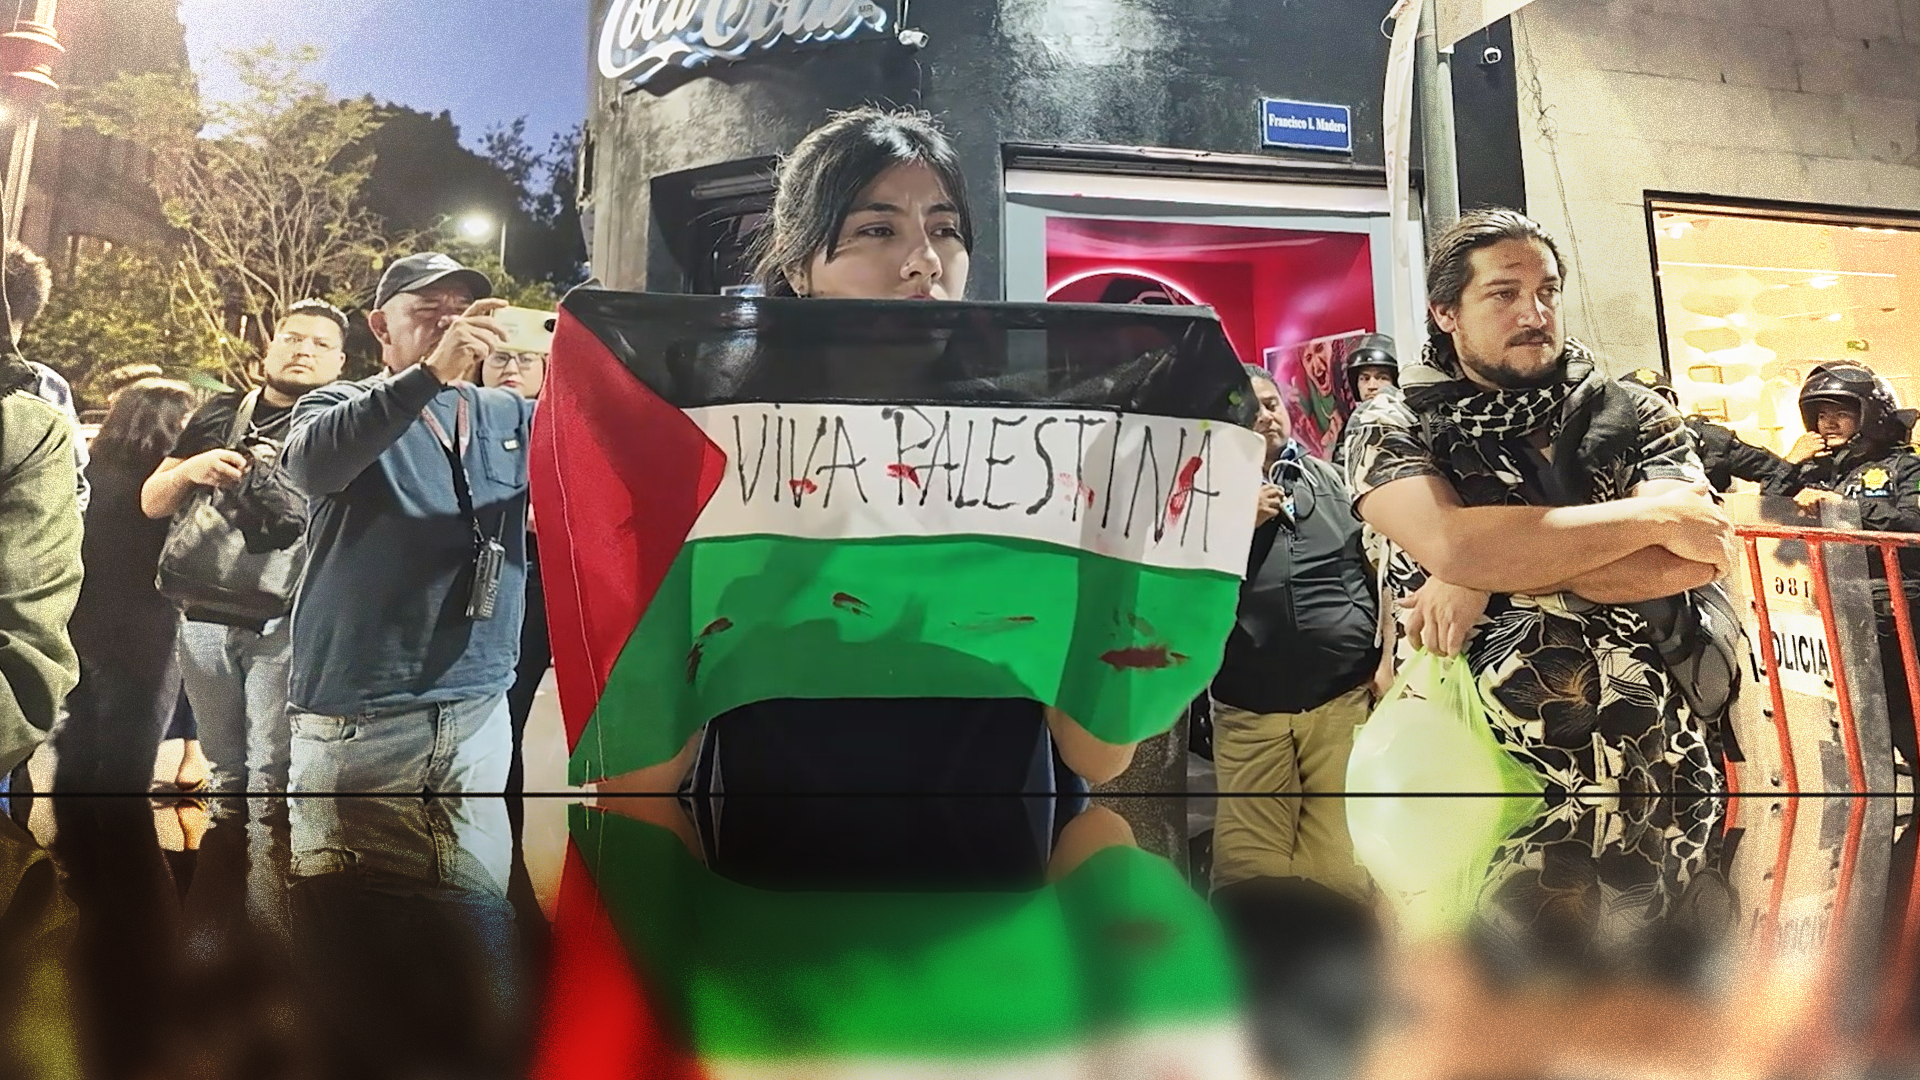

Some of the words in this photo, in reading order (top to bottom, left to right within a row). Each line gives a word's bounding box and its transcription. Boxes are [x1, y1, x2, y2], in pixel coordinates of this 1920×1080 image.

[1268, 113, 1307, 129] Francisco
[1316, 118, 1347, 133] Madero
[733, 404, 867, 508] VIVA
[882, 405, 1220, 552] PALESTINA
[1759, 630, 1830, 676] OLICIA
